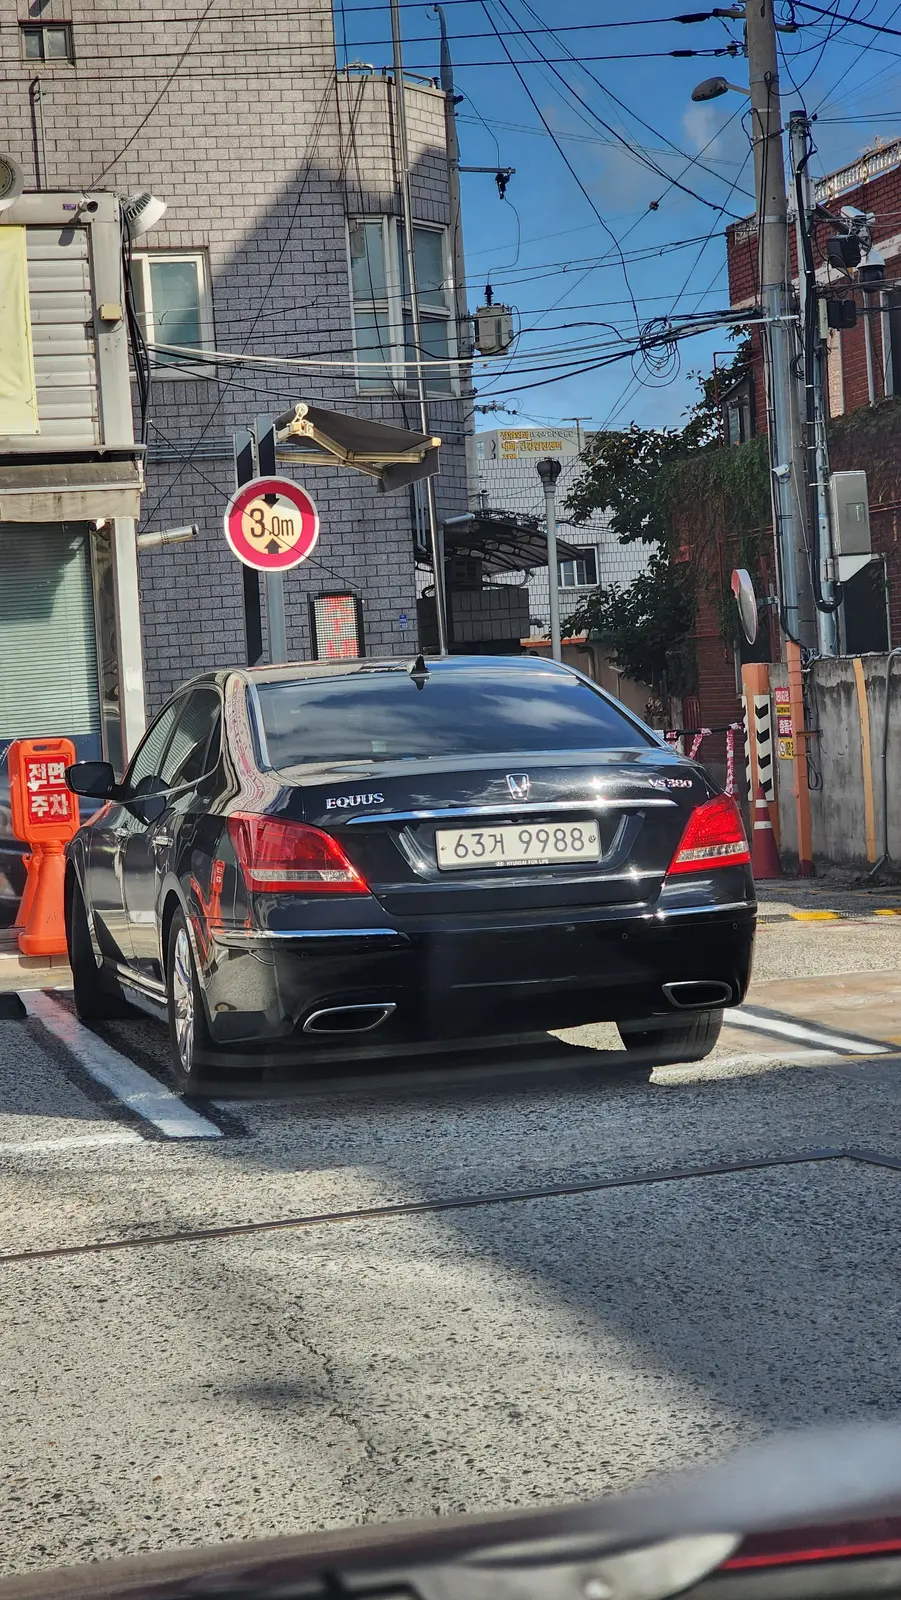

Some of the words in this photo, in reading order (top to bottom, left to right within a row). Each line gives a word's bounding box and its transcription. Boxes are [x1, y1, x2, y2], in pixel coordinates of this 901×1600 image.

[250, 508, 295, 538] 3.0m
[28, 762, 66, 785] 전면
[31, 794, 68, 817] 주차
[325, 792, 385, 809] EQUUS
[454, 833, 505, 858] 63거
[518, 827, 585, 854] 9988
